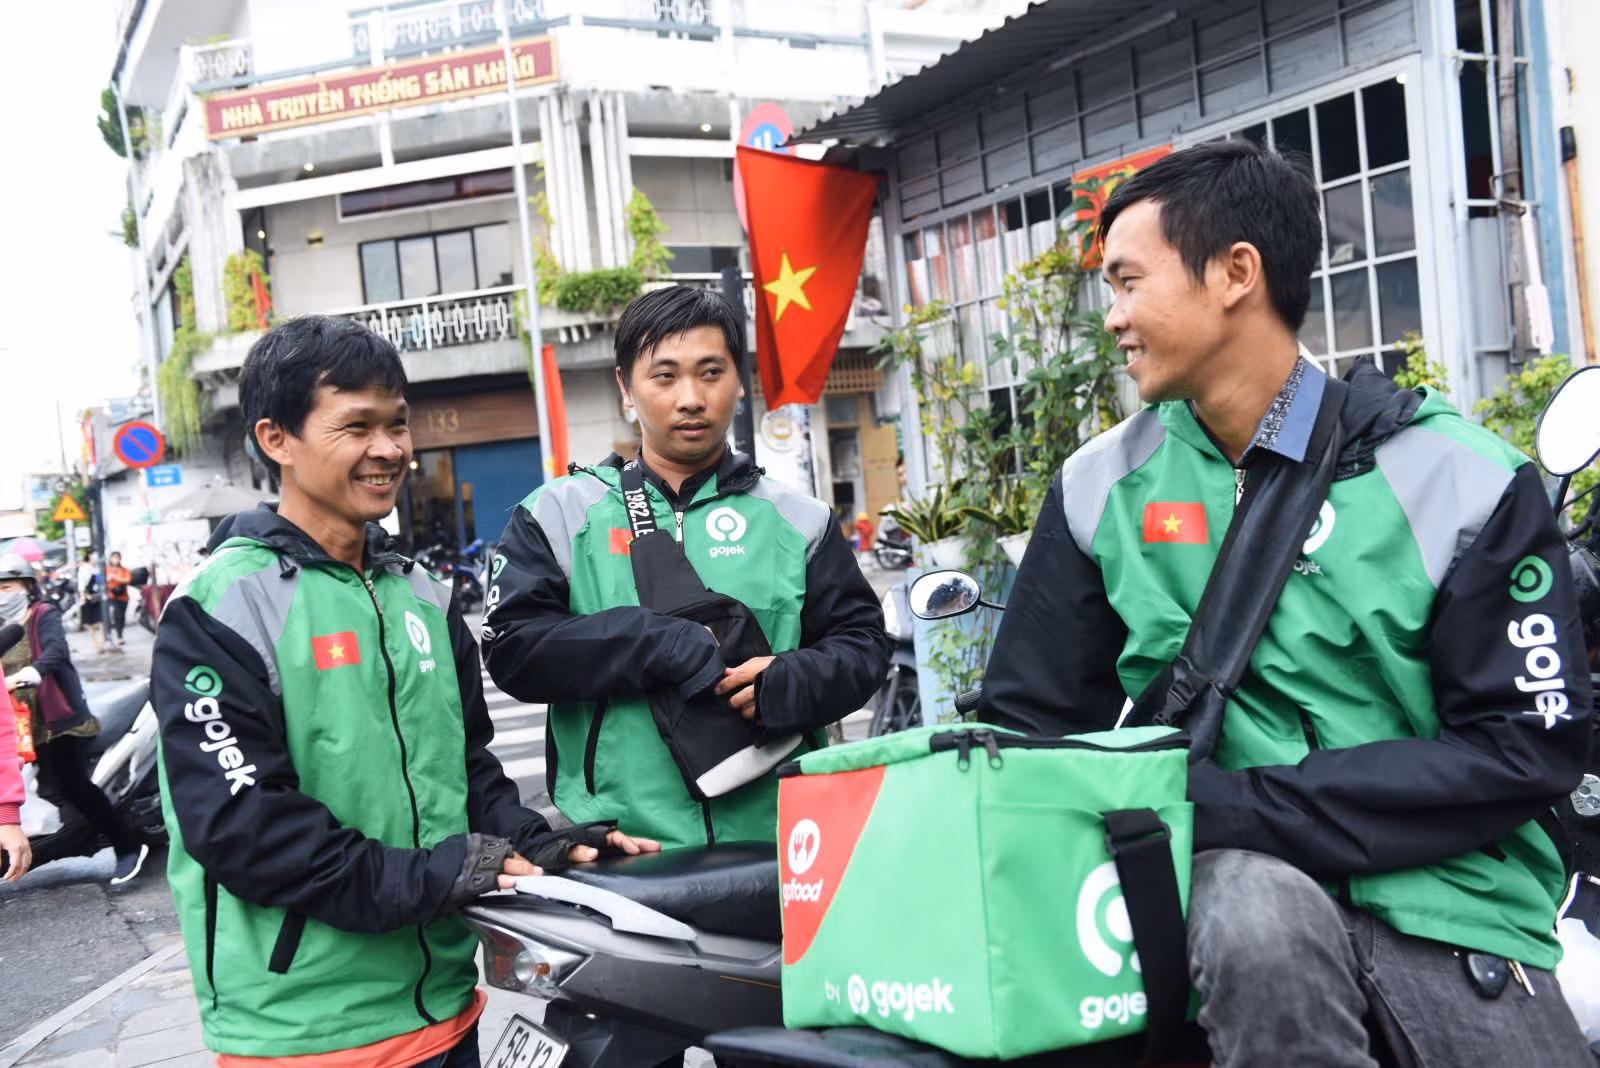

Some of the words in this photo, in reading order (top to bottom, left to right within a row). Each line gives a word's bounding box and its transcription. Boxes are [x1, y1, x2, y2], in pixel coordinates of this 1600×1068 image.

[221, 97, 264, 130] NHÀ
[349, 70, 421, 108] THỐNG
[425, 64, 470, 95] SÂN
[427, 408, 460, 433] 133
[708, 544, 746, 558] gojek
[1507, 613, 1573, 730] gojek
[184, 696, 257, 796] gojek
[782, 876, 824, 908] gofood
[871, 976, 955, 1022] gojek
[1080, 991, 1148, 1031] goje
